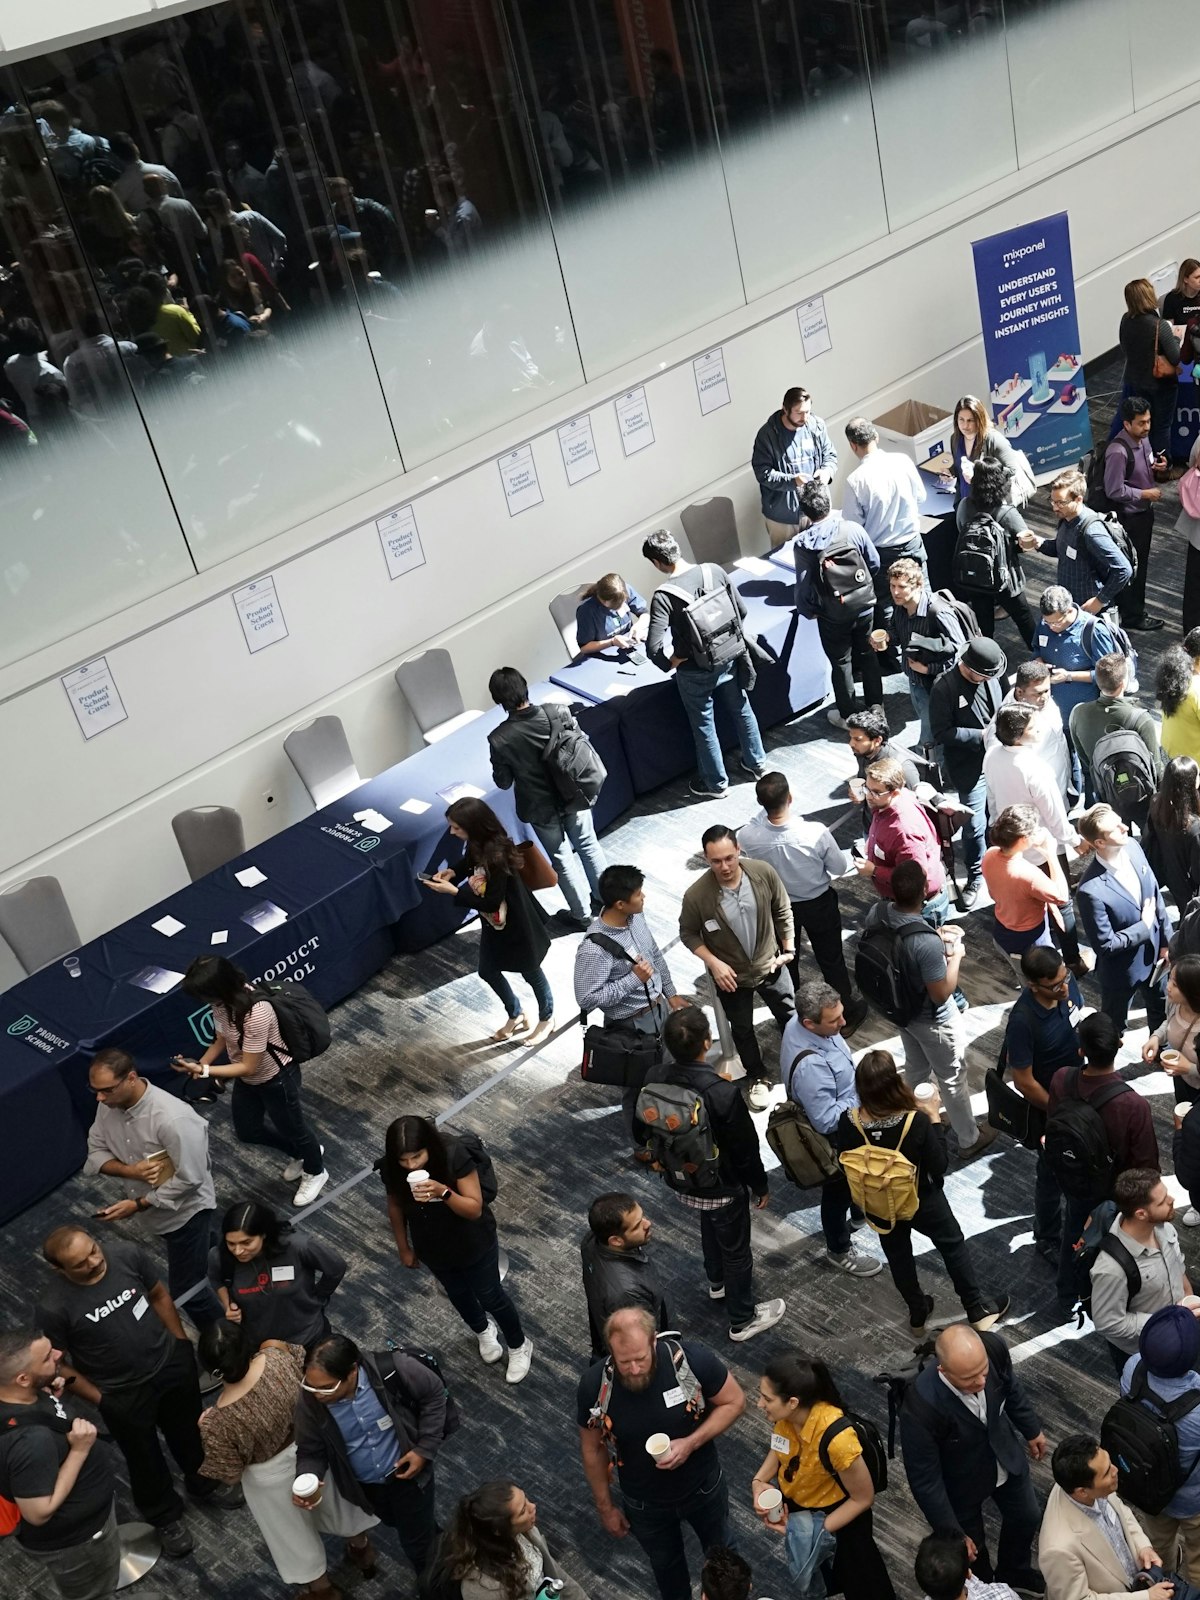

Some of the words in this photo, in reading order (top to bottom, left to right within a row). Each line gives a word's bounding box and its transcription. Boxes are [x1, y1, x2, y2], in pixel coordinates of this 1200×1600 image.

[1003, 238, 1045, 262] mixpanel
[998, 267, 1056, 293] UNDERSTAND
[1000, 290, 1027, 308] EVERY
[1028, 281, 1058, 298] USER'S
[1000, 302, 1038, 323] JOURNEY
[1039, 294, 1062, 308] WITH
[804, 319, 823, 332] General
[994, 319, 1030, 339] INSTANT
[1031, 306, 1070, 326] INSIGHTS
[701, 371, 722, 385] General
[625, 412, 644, 424] Product
[627, 418, 643, 428] School
[569, 440, 587, 452] Product
[572, 446, 587, 457] School
[510, 470, 530, 483] Product
[512, 476, 529, 488] School
[388, 531, 413, 546] Product
[392, 538, 412, 552] School
[394, 546, 413, 558] Guest
[246, 603, 273, 619] Product
[250, 610, 273, 625] School
[254, 618, 274, 631] Guest
[78, 685, 109, 704] Product
[83, 692, 109, 709] School
[88, 700, 110, 715] Guest
[320, 826, 355, 843] PRODUCT
[334, 823, 363, 838] SCHOOL
[25, 1035, 54, 1053] SCHOOL
[35, 1027, 70, 1049] PRODUCT
